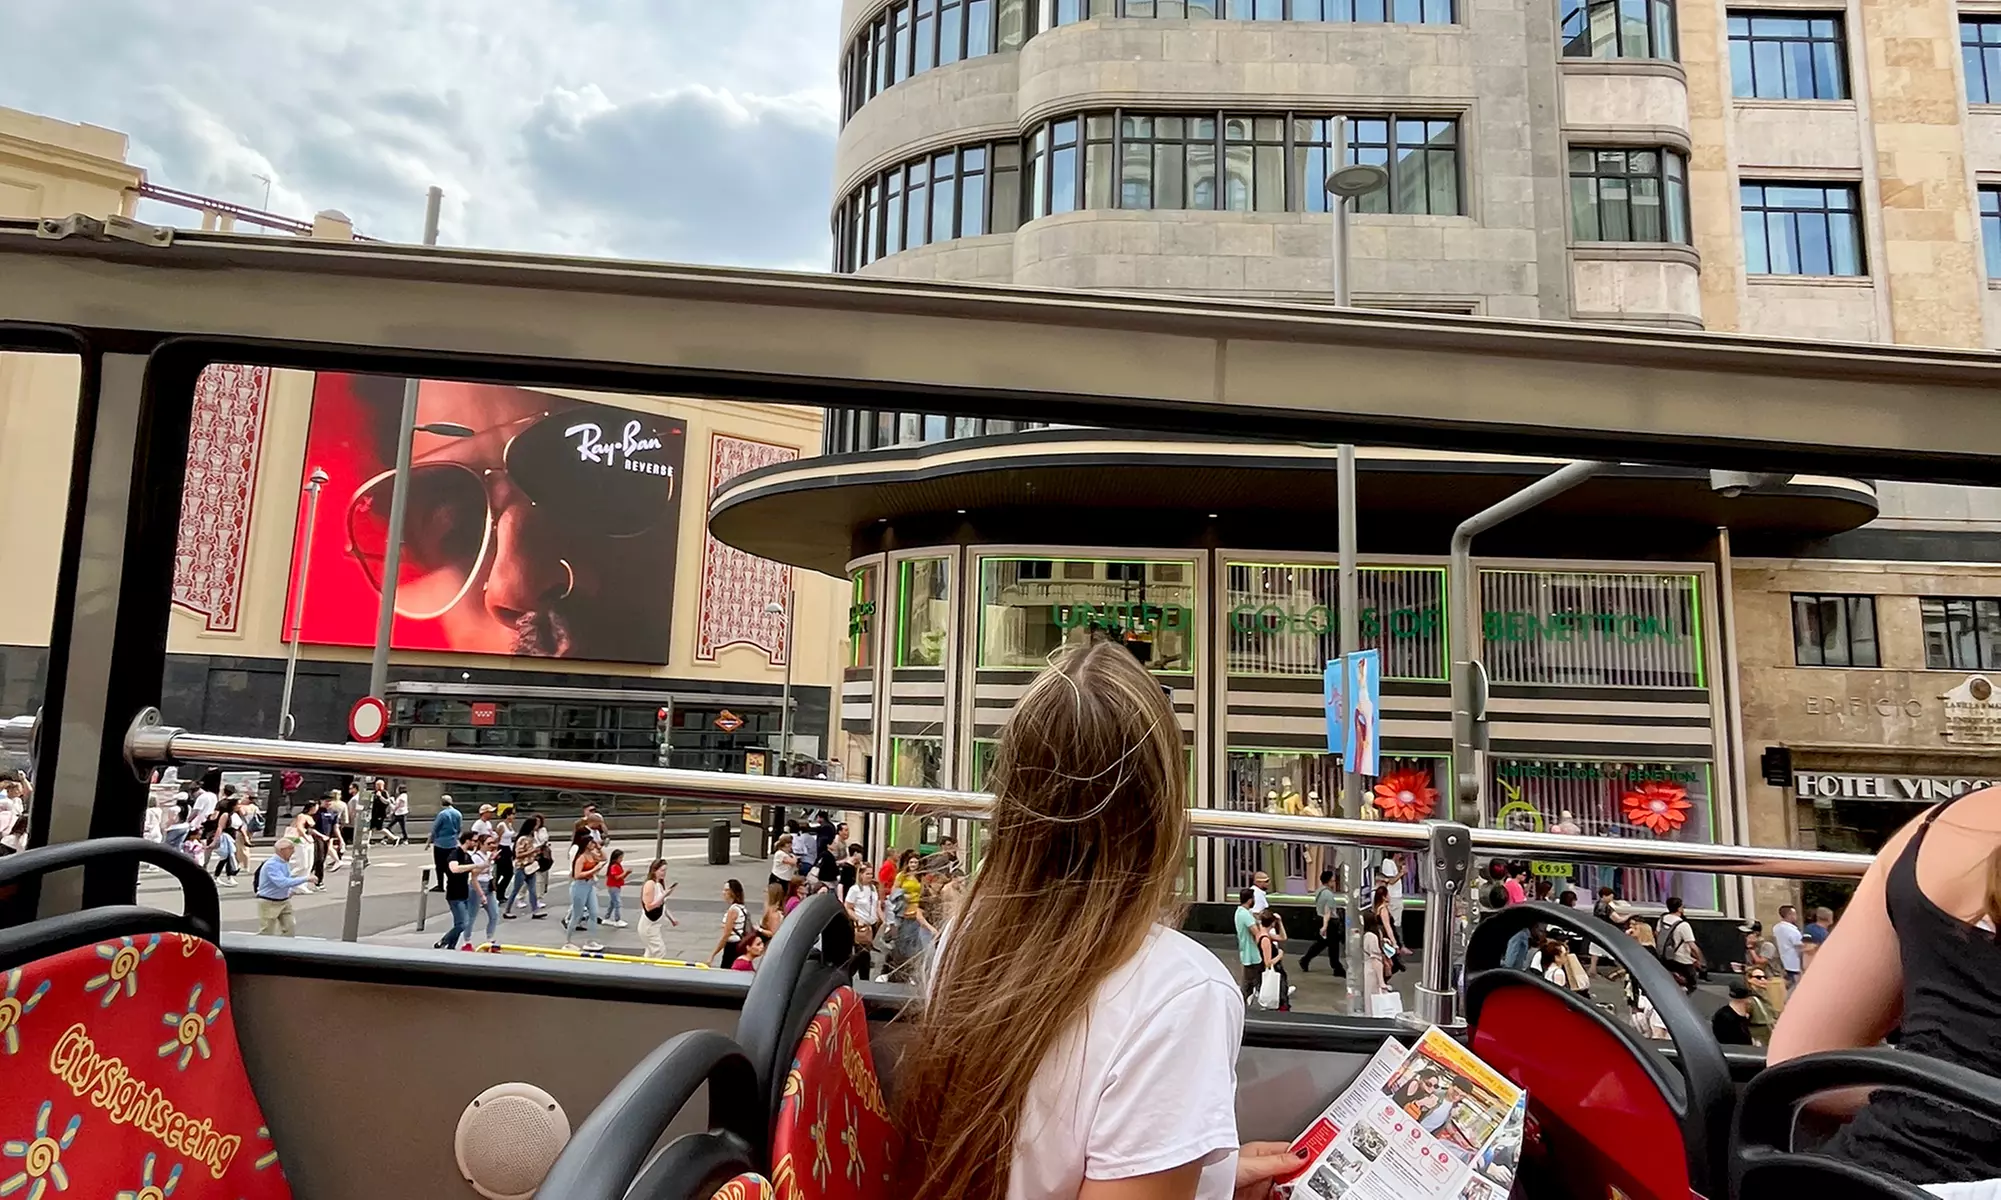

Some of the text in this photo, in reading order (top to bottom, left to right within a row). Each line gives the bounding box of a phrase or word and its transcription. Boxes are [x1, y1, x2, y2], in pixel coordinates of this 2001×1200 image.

[625, 459, 674, 477] REVERSE
[1053, 600, 1191, 632] UNITED
[1231, 604, 1381, 637] COLOS
[1390, 607, 1440, 638] OF
[1806, 695, 1922, 718] EDIFICIO
[1497, 766, 1547, 777] UNITED
[1551, 767, 1604, 780] COLORS
[1799, 774, 1894, 798] HOTEL
[1537, 864, 1568, 875] €9.95
